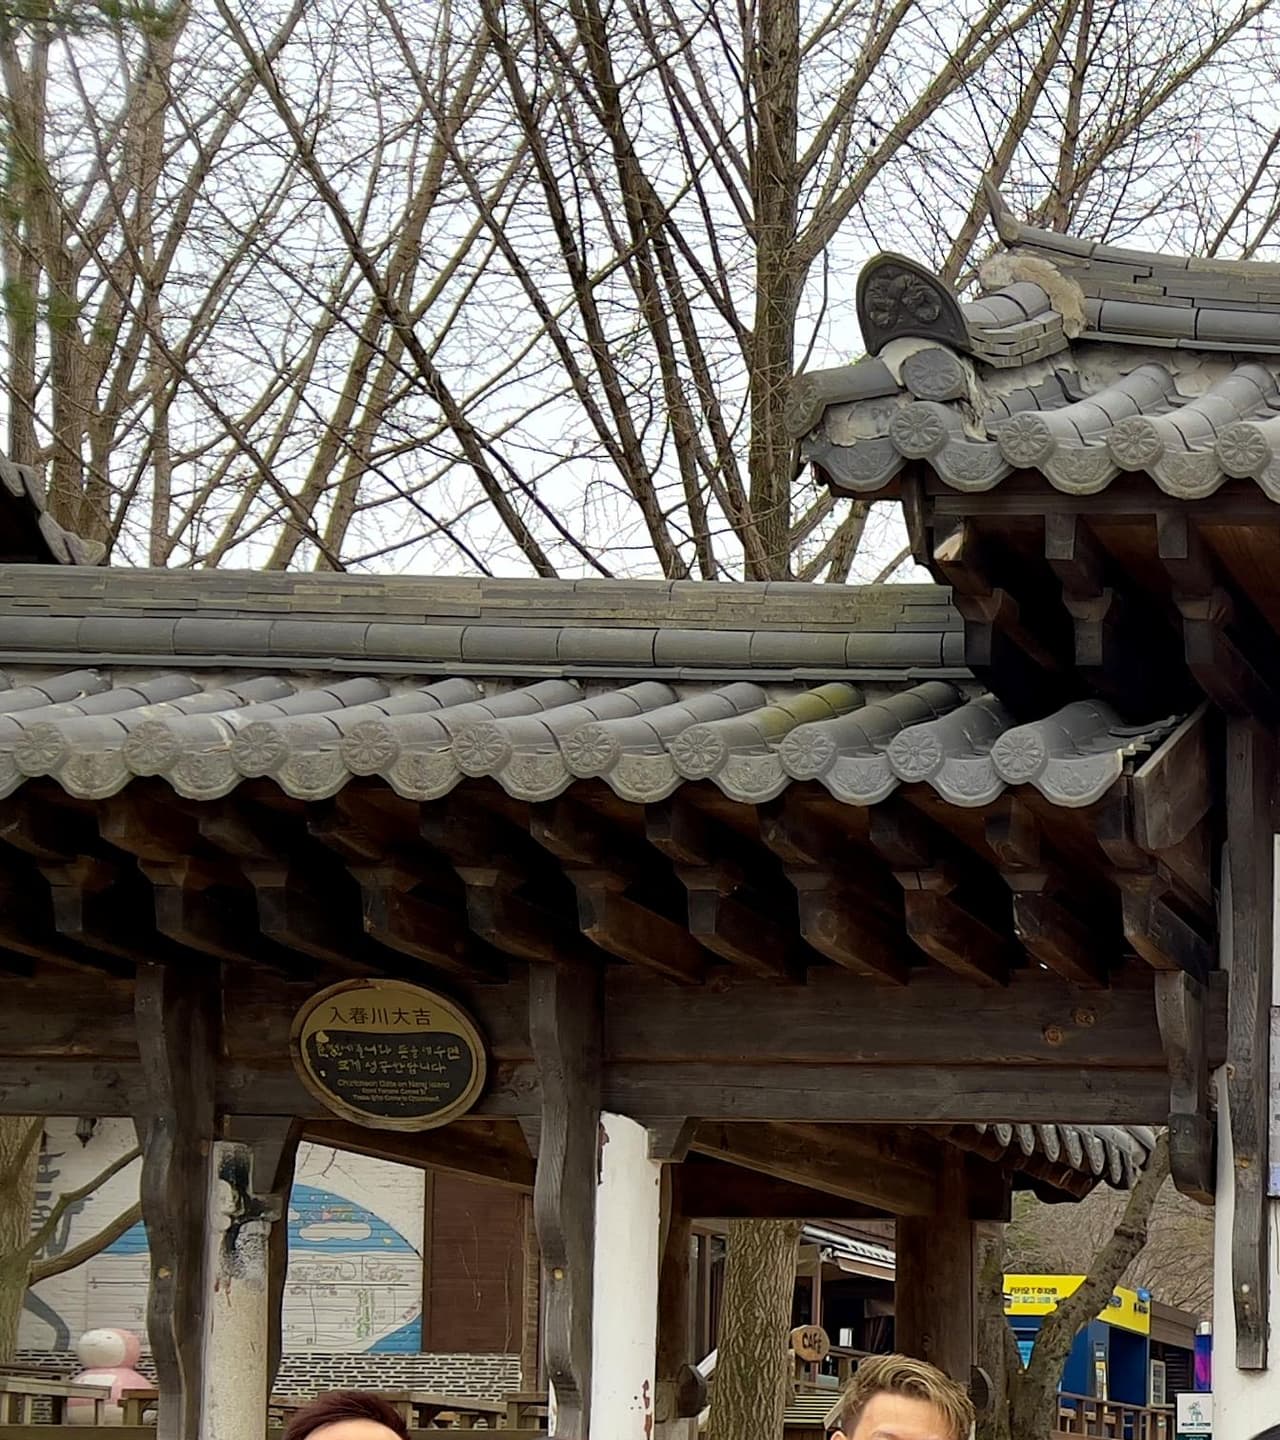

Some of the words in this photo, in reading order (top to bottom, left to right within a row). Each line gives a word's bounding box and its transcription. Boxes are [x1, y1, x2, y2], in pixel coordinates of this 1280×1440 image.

[329, 1006, 431, 1026] 入春川大吉
